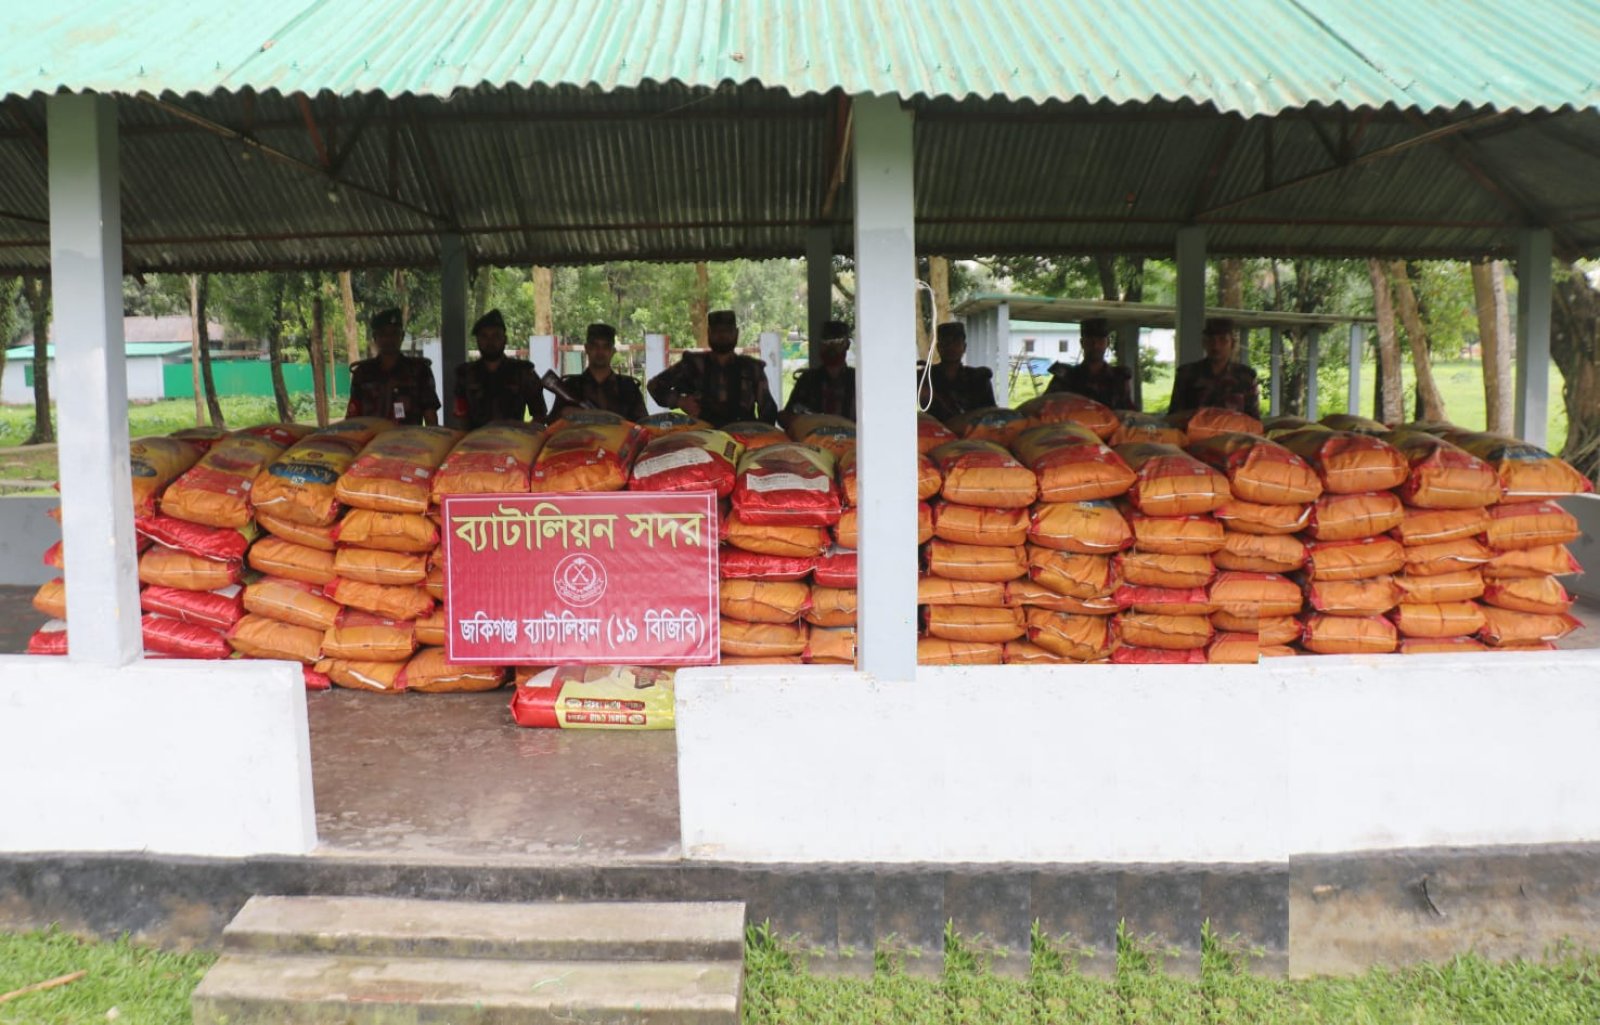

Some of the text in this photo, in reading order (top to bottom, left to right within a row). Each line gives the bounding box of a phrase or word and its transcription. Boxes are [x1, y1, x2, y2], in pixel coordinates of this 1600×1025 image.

[451, 503, 705, 552] ব্যাটালিয়ন সদর
[458, 609, 706, 649] জকিগঞ্জ ব্যাটালিয়ন (১৯ বিজিবি)
